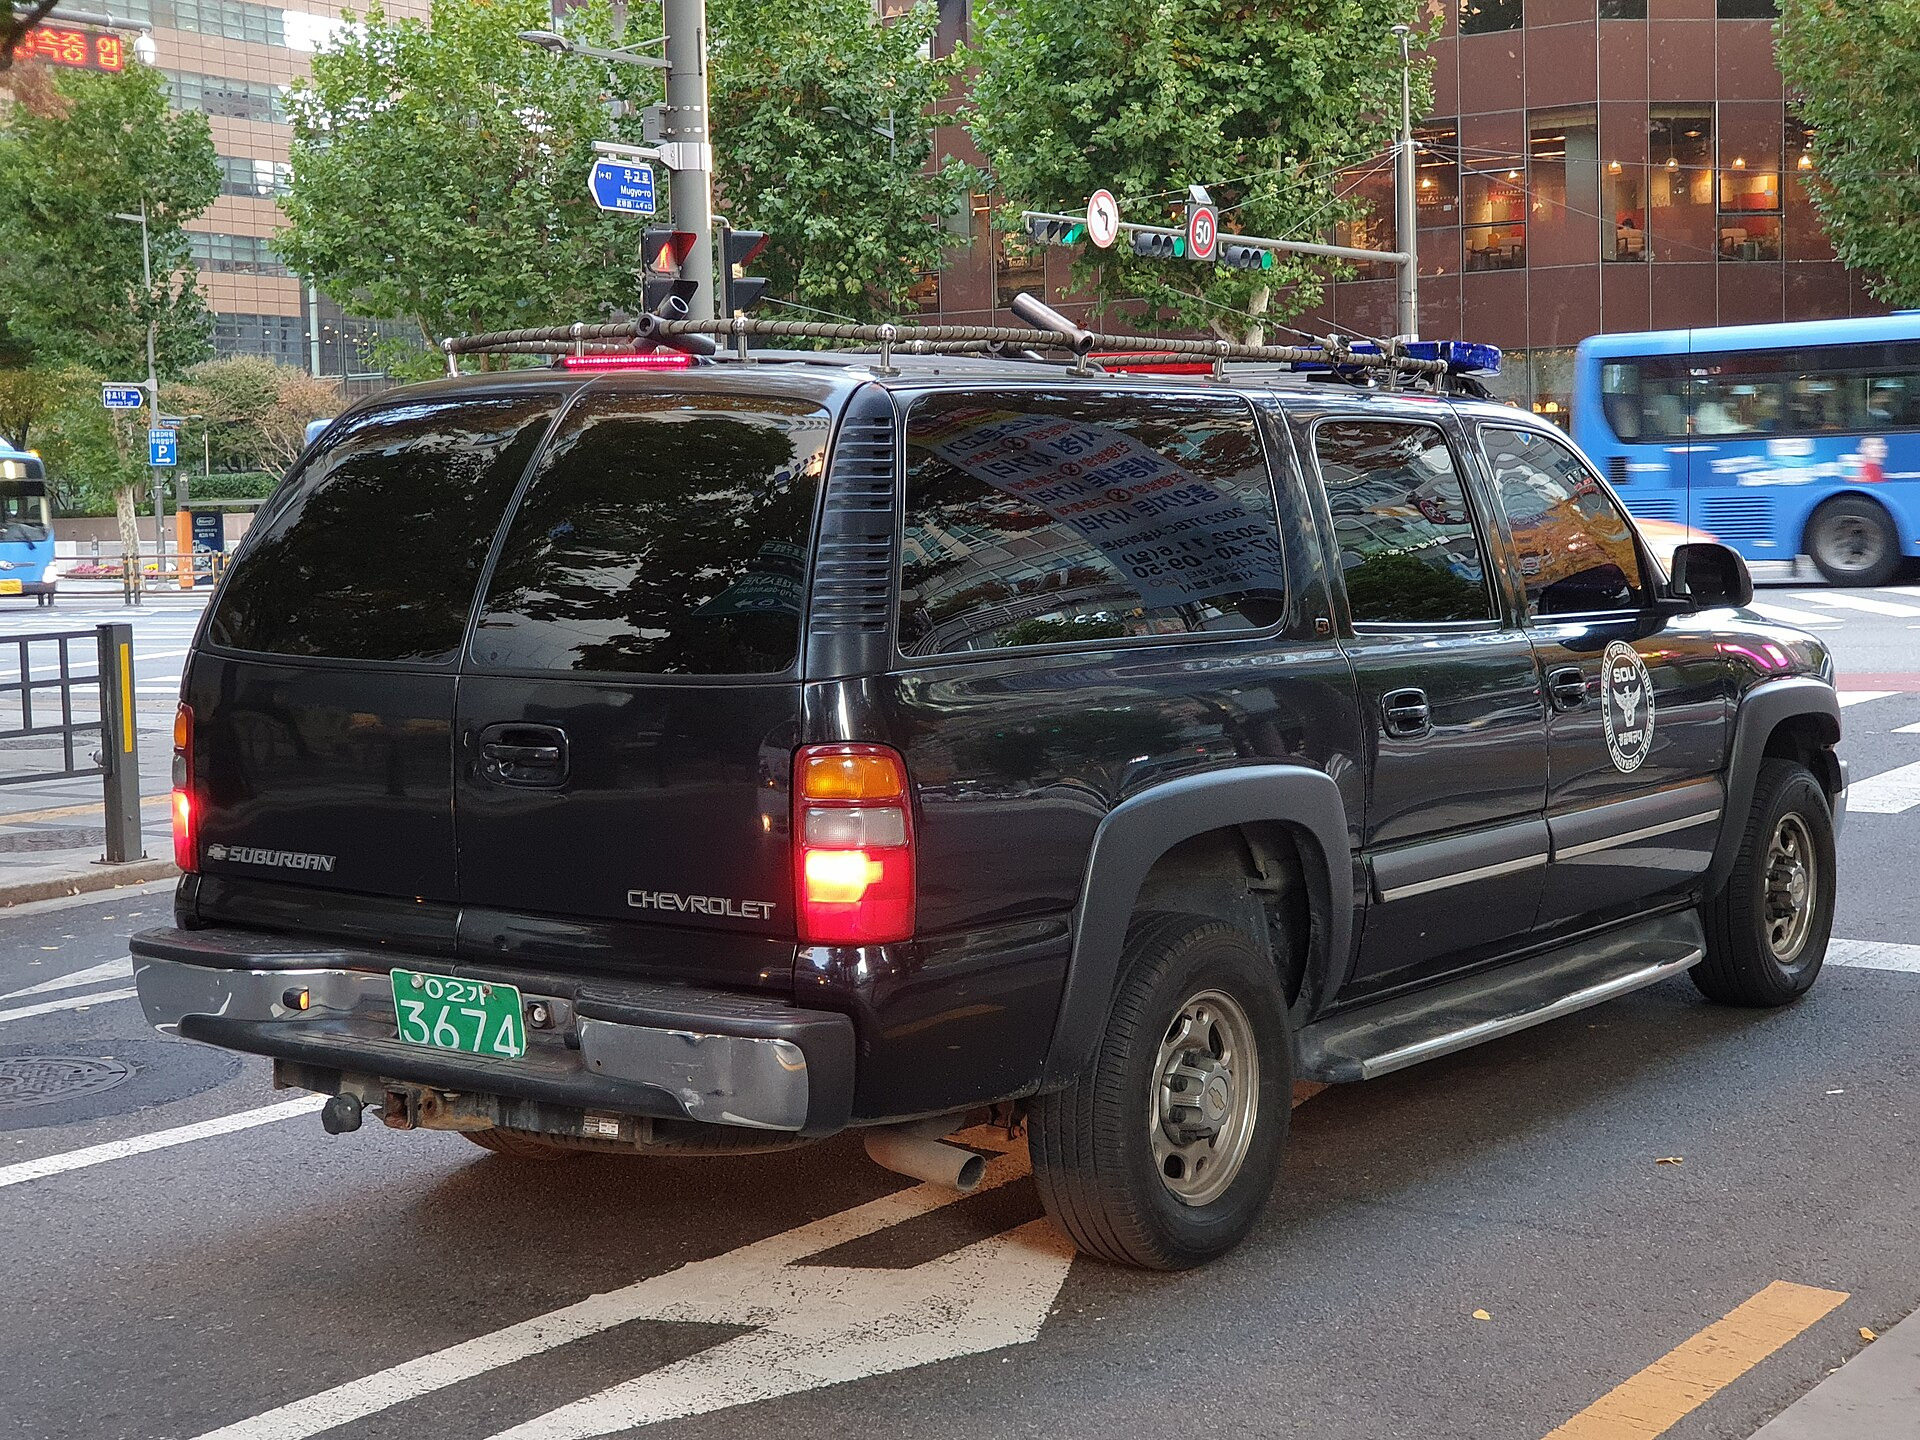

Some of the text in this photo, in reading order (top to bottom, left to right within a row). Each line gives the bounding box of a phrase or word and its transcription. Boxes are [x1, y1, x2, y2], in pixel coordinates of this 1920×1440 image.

[624, 169, 650, 184] 무교로
[620, 185, 652, 198] Mugyo-ro
[1196, 220, 1211, 244] 50
[158, 446, 168, 457] P
[1609, 643, 1641, 667] OPERATION
[1612, 666, 1636, 683] SOU
[1611, 745, 1640, 769] OPERATION
[228, 846, 336, 872] SUBURBAN
[627, 889, 776, 920] CHEVROLET
[425, 978, 488, 1006] 02가
[400, 999, 520, 1057] 3674
